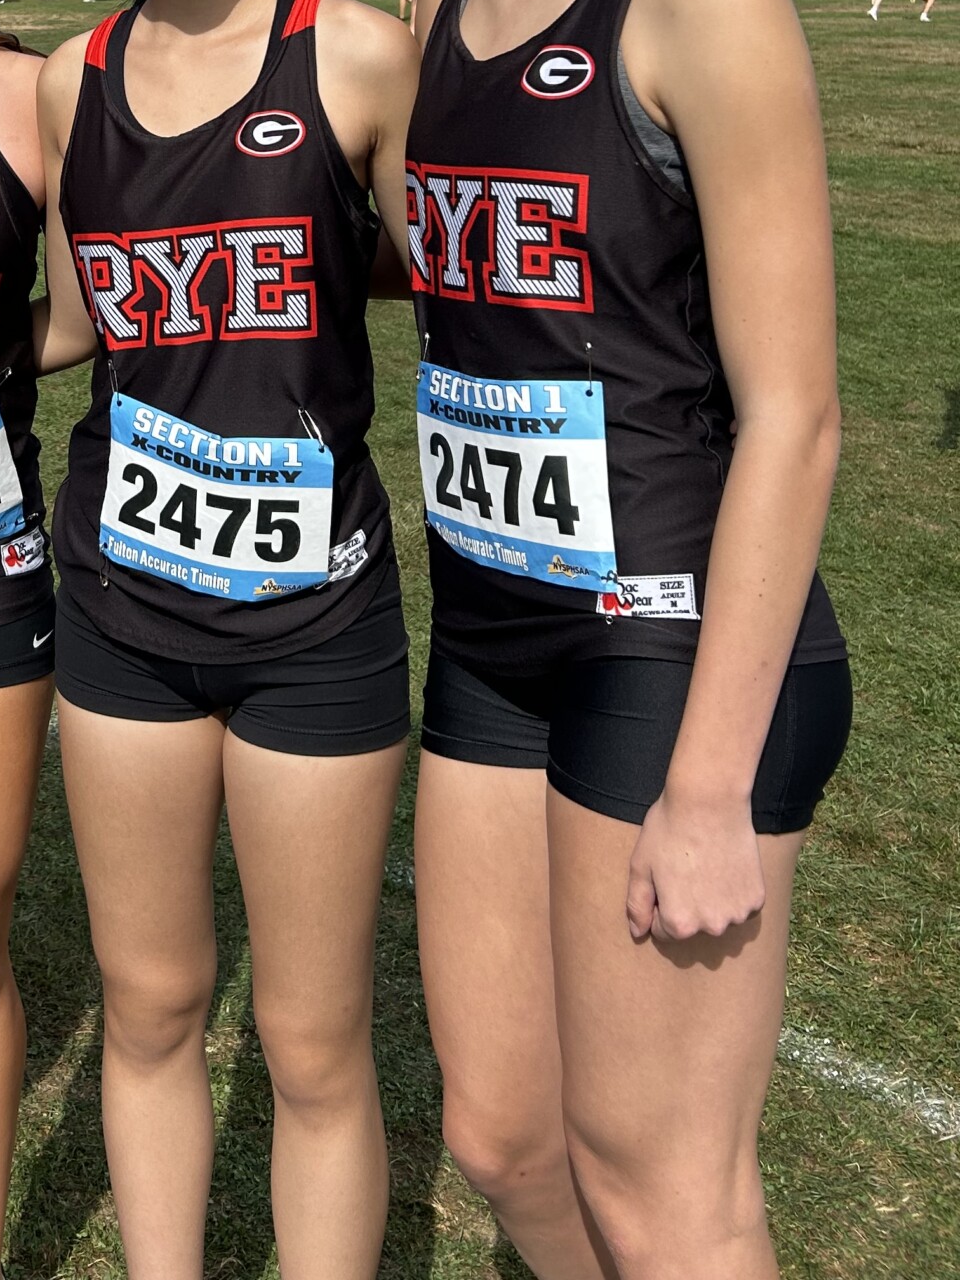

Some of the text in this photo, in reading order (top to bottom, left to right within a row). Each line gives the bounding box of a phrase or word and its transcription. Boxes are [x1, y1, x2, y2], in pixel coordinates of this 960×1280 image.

[75, 221, 313, 346] RYE
[429, 369, 567, 413] SECTION 1
[429, 399, 567, 434] X-COUNTRY
[130, 433, 303, 483] X-COUNTRY
[132, 407, 303, 467] SECTION 1
[429, 431, 580, 537] 2474
[118, 463, 301, 563] 2475
[108, 535, 231, 594] Fulton Accurate Timing
[458, 530, 495, 559] Accurate
[494, 541, 529, 572] Timing
[659, 580, 685, 590] SIZE
